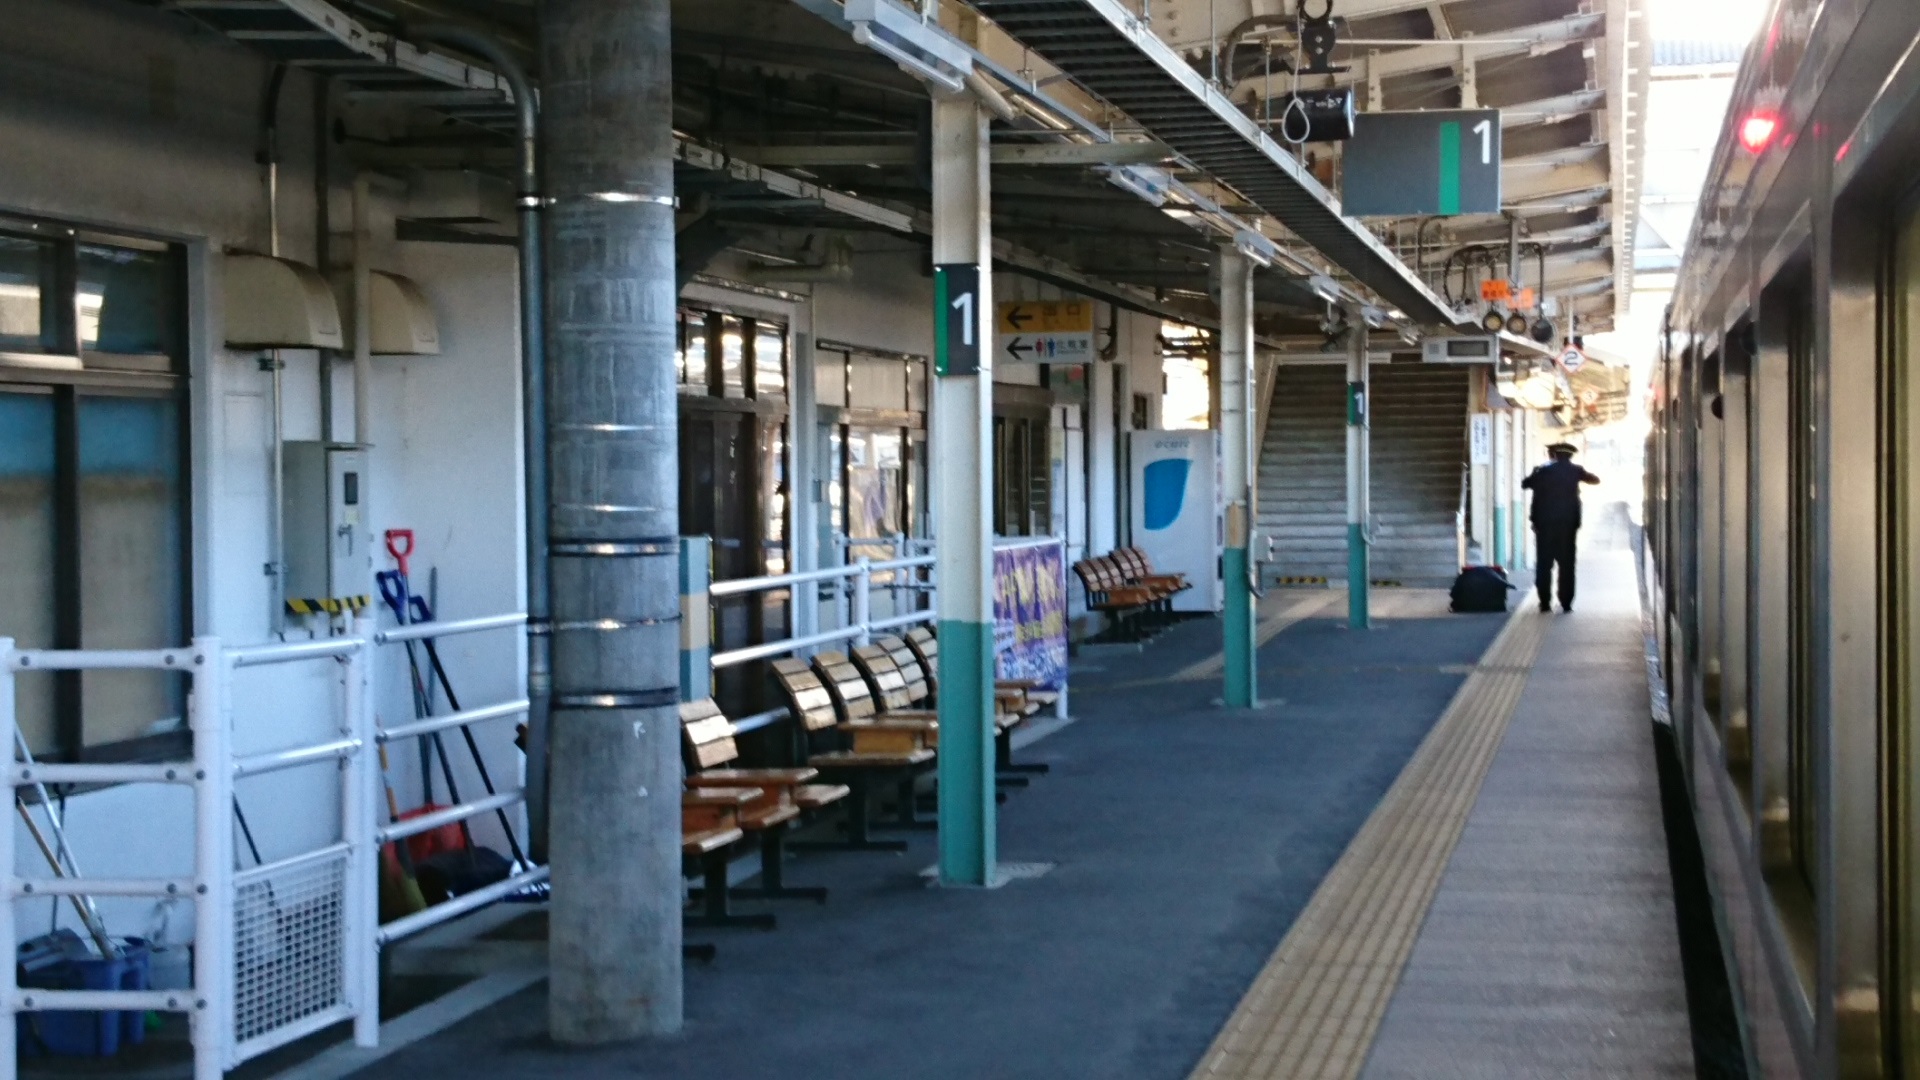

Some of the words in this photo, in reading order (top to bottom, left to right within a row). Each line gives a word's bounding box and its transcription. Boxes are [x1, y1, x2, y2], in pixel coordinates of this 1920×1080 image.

[1473, 120, 1490, 164] 1
[952, 292, 972, 345] 1
[1564, 350, 1579, 366] 2
[1354, 392, 1363, 414] 1
